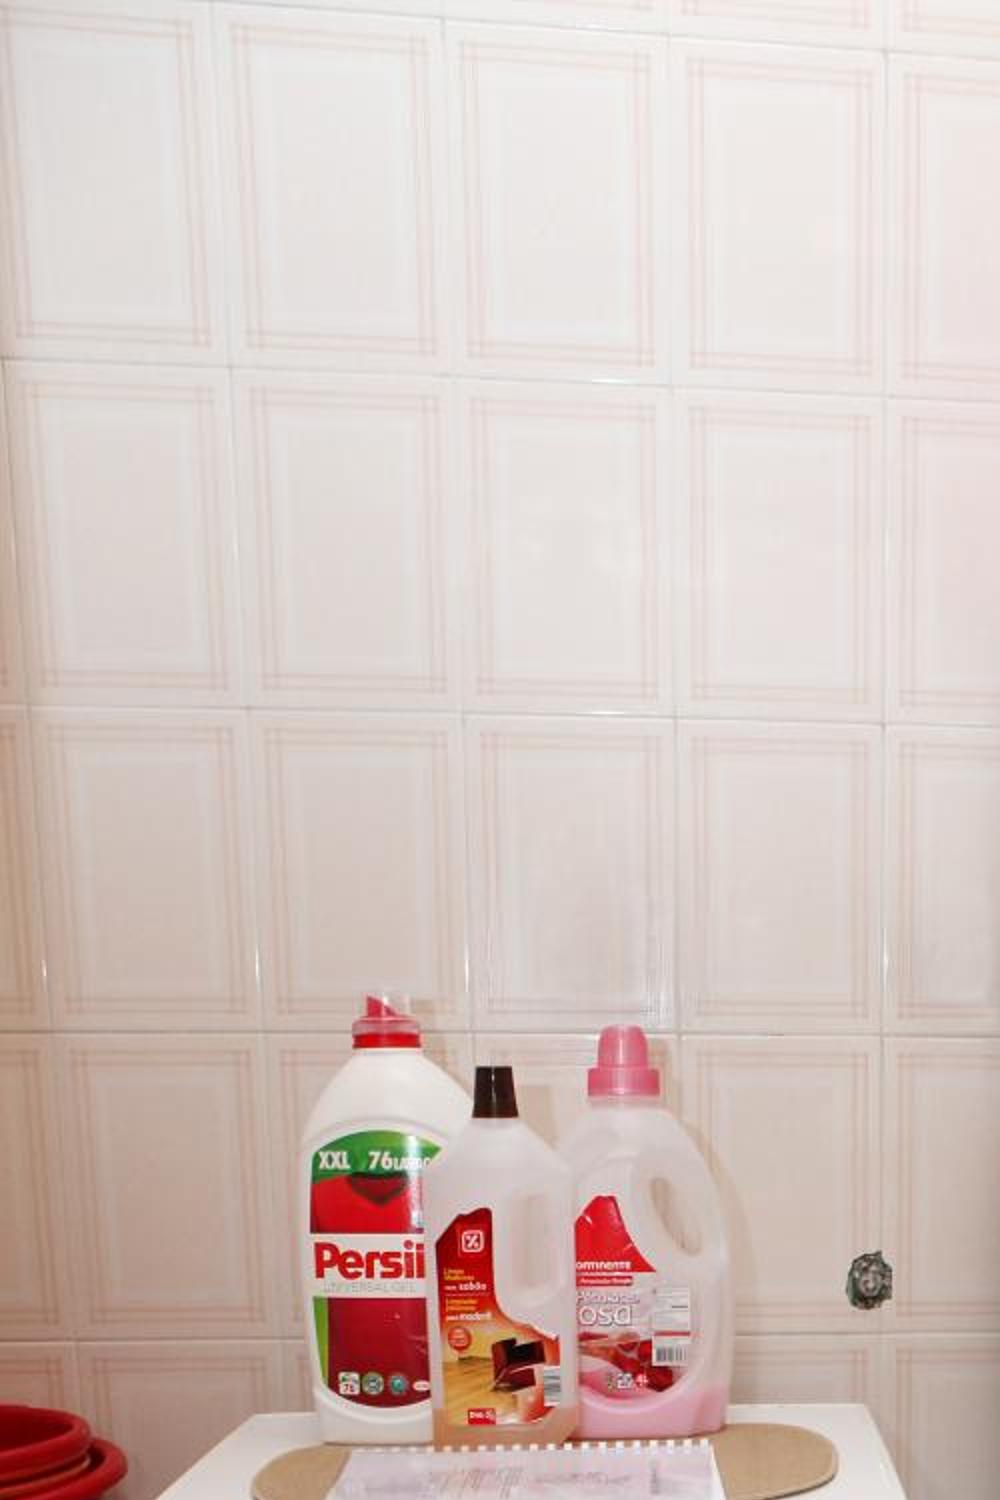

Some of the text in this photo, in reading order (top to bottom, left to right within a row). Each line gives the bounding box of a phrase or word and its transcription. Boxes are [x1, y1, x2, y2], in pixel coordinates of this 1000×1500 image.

[318, 1150, 351, 1169] XXL
[368, 1150, 393, 1170] 76
[313, 1239, 426, 1281] Persil
[576, 1260, 632, 1270] ontinente
[579, 1304, 634, 1327] osa
